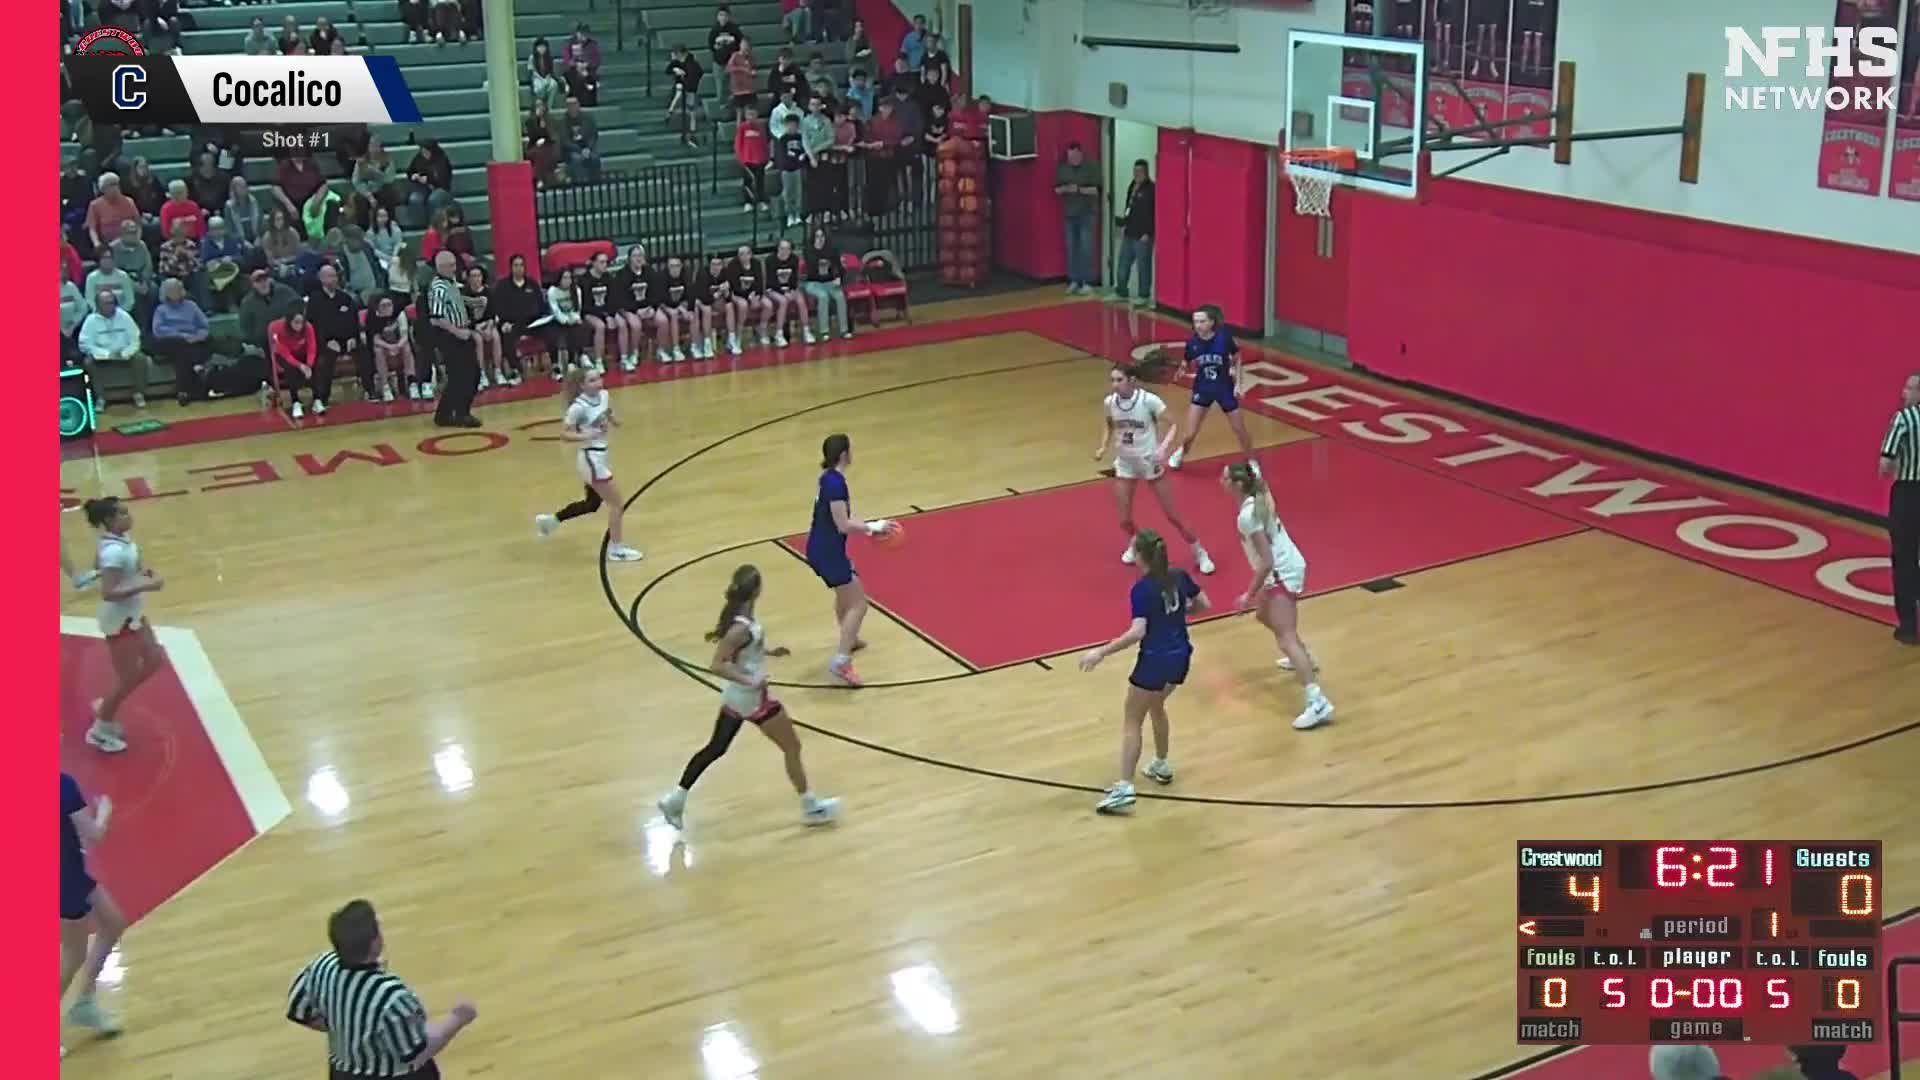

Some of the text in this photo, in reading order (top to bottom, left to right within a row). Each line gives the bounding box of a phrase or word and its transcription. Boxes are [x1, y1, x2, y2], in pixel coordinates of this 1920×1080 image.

[1521, 847, 1602, 867] Crestwood
[1796, 848, 1871, 867] Guests
[1568, 875, 1600, 913] 4
[1841, 874, 1873, 915] 0
[1664, 917, 1729, 937] period
[1771, 911, 1779, 937] 1
[1527, 948, 1576, 966] fouls
[1663, 947, 1731, 968] player
[1818, 949, 1867, 967] fouls
[1543, 977, 1568, 1008] 0
[1603, 977, 1626, 1008] 5
[1650, 977, 1743, 1009] 0-00
[1766, 978, 1790, 1009] 5
[1837, 978, 1860, 1009] 0
[1521, 1019, 1579, 1038] match
[1670, 1021, 1723, 1039] game
[1813, 1021, 1873, 1040] match
